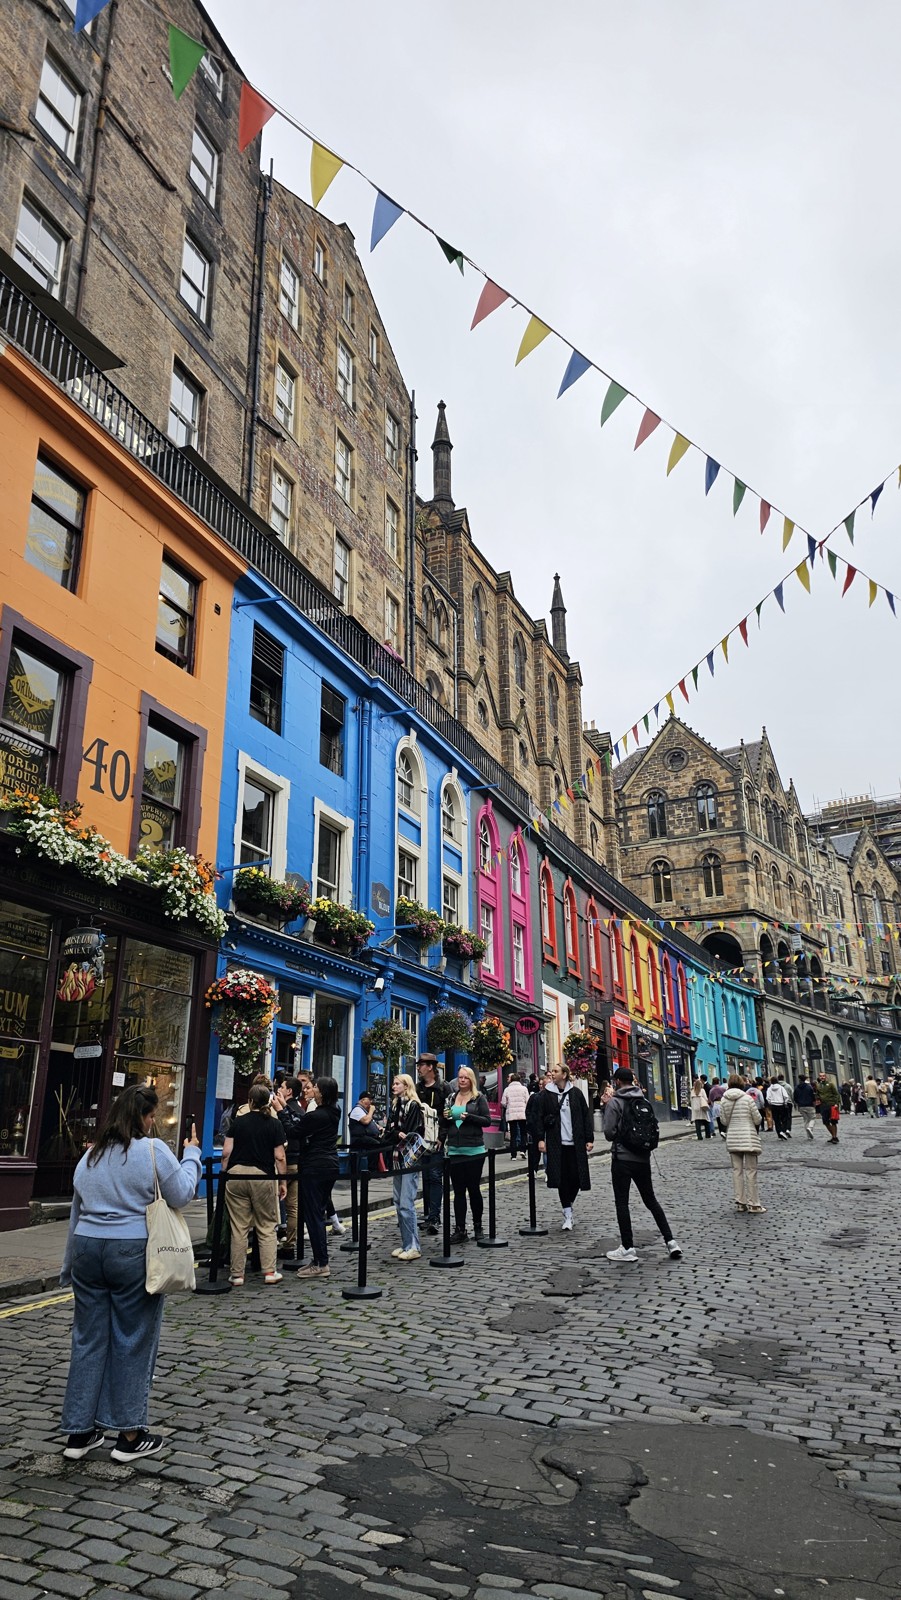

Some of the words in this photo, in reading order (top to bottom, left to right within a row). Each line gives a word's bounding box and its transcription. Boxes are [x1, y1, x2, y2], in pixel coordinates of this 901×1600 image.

[0, 750, 39, 774] WORLD
[83, 737, 131, 802] 40
[140, 804, 170, 826] UPERIOR
